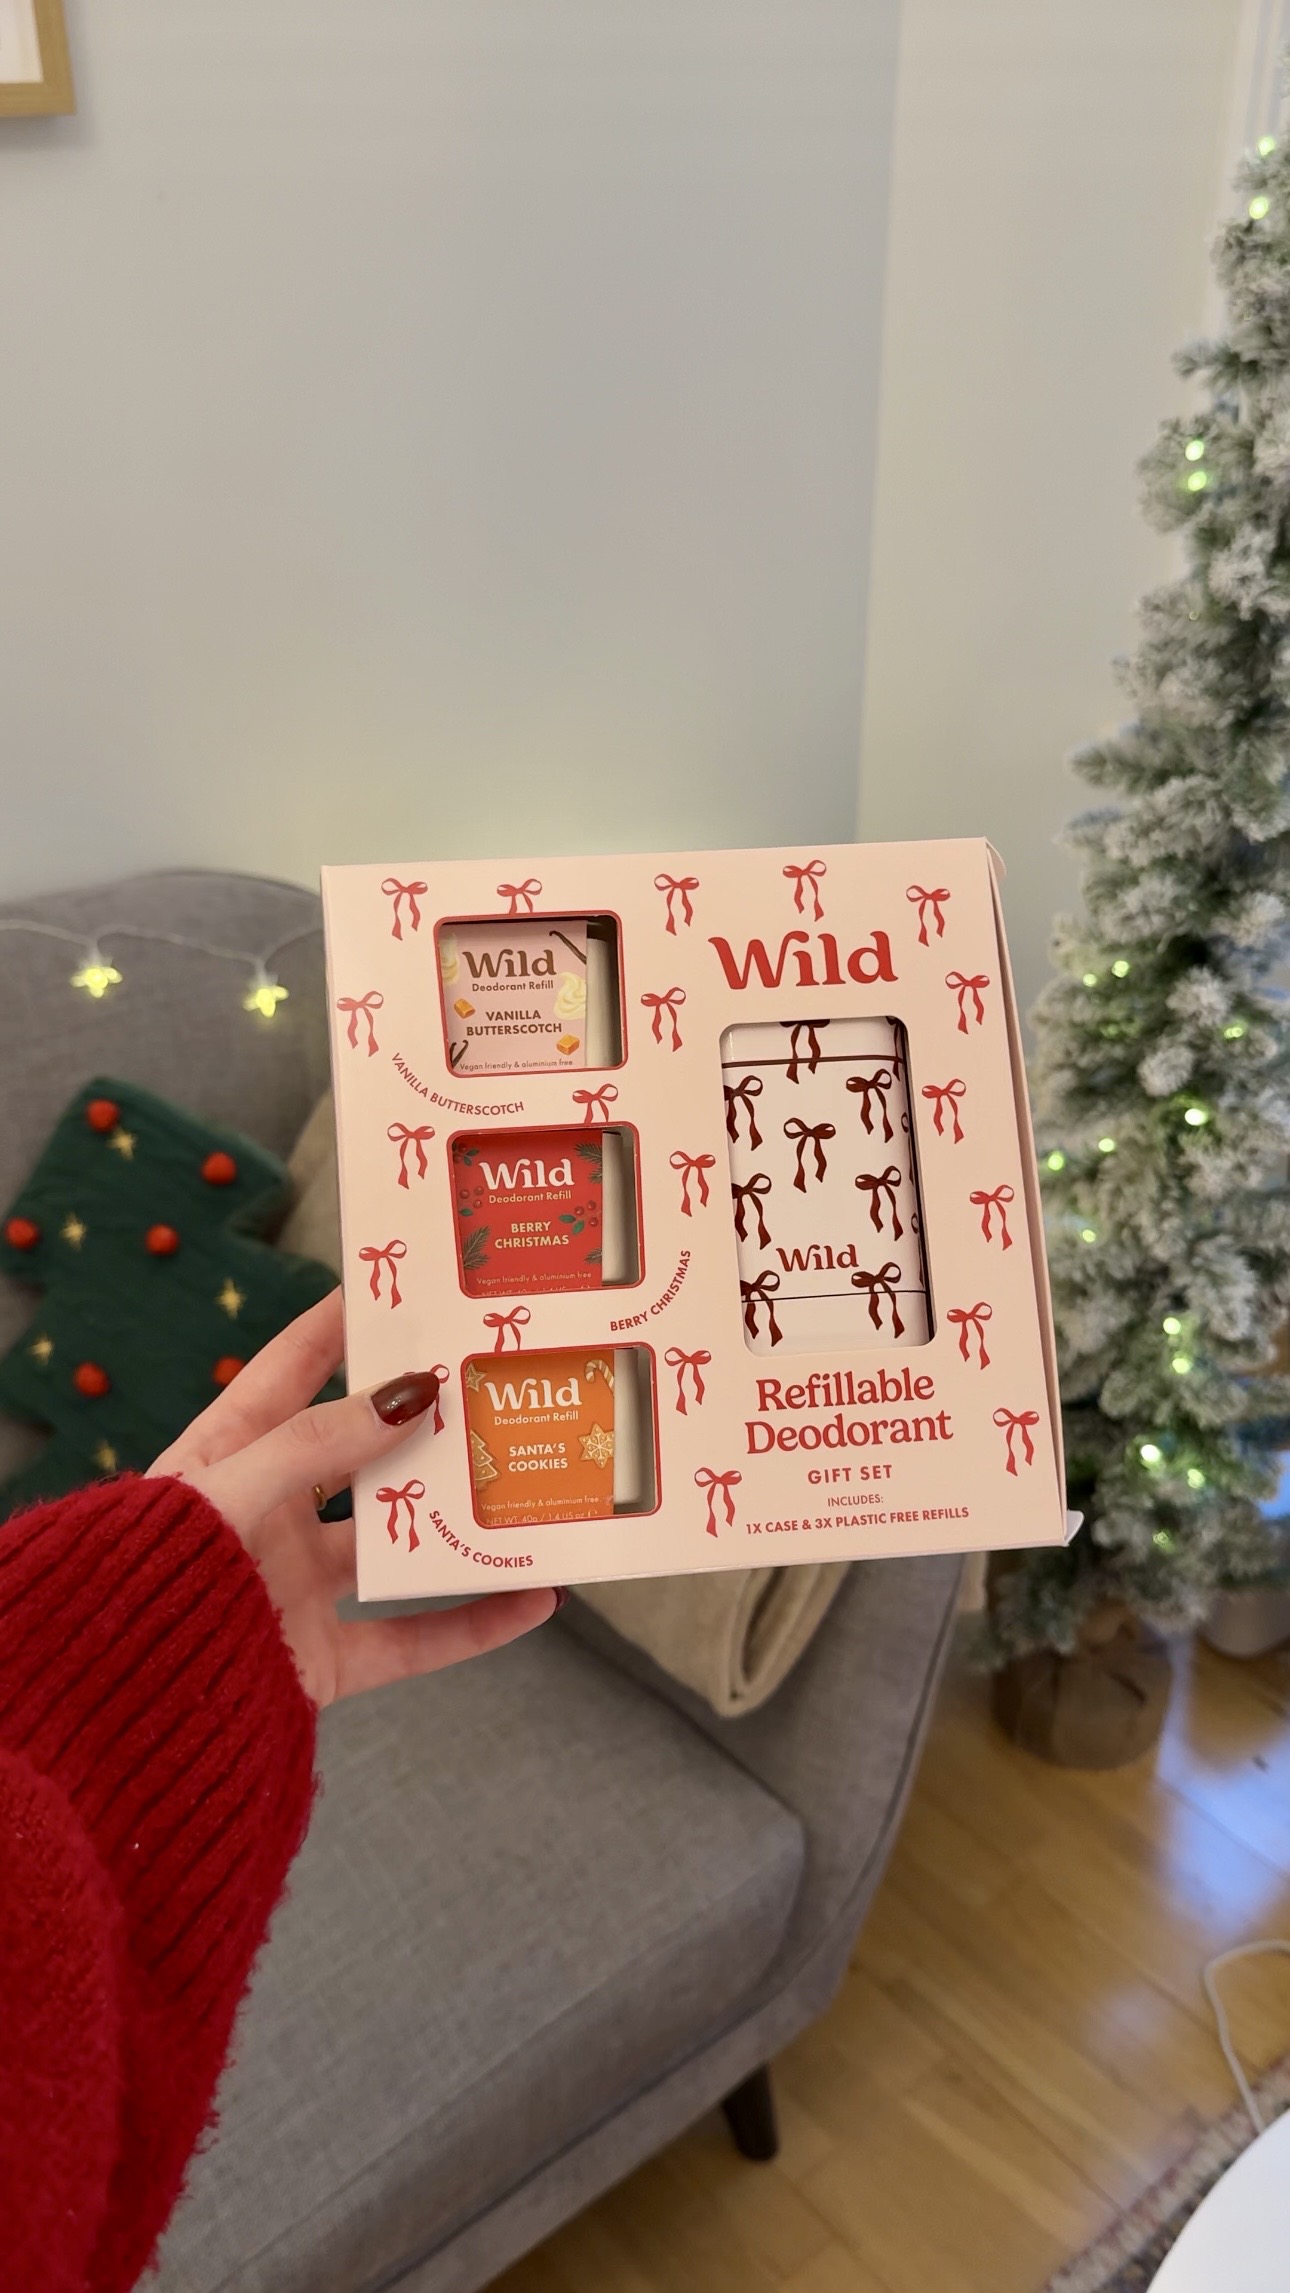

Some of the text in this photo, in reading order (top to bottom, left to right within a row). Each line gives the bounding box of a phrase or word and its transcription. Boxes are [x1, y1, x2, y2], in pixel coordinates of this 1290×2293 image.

[462, 949, 557, 978] Wild
[708, 930, 898, 990] Wild
[472, 980, 554, 992] Deodorant Refill
[485, 1010, 541, 1021] VANILLA
[466, 1023, 562, 1036] BUTTERSCOTCH
[460, 1063, 483, 1071] Vegan
[484, 1061, 512, 1070] friendly
[521, 1060, 557, 1068] aluminium
[559, 1058, 573, 1066] free
[392, 1052, 525, 1116] VANILLA BUTTERSCOTCH
[479, 1158, 574, 1190] Wild
[489, 1190, 572, 1204] Deodorant Refill
[511, 1221, 552, 1233] BERRY
[495, 1235, 570, 1249] CHRISTMAS
[776, 1244, 859, 1272] Wild
[476, 1277, 500, 1286] Vegan
[502, 1274, 529, 1284] friendly
[539, 1273, 575, 1281] aluminium
[610, 1250, 691, 1331] BERRY CHRISTMAS
[484, 1377, 582, 1411] Wild
[755, 1366, 935, 1411] Refillable
[494, 1410, 579, 1426] Deodorant Refill
[744, 1410, 954, 1454] Deodorant
[509, 1442, 566, 1457] SANTA'S
[508, 1457, 568, 1472] COOKIES
[808, 1464, 893, 1485] GIFT SET
[481, 1495, 599, 1512] Vegan friendly & aluminium free
[827, 1494, 884, 1507] INCLUDES:
[746, 1507, 969, 1534] 1X CASE & 3X PLASTIC FREE REFILLS
[429, 1510, 533, 1568] SANTA'S COOKIES
